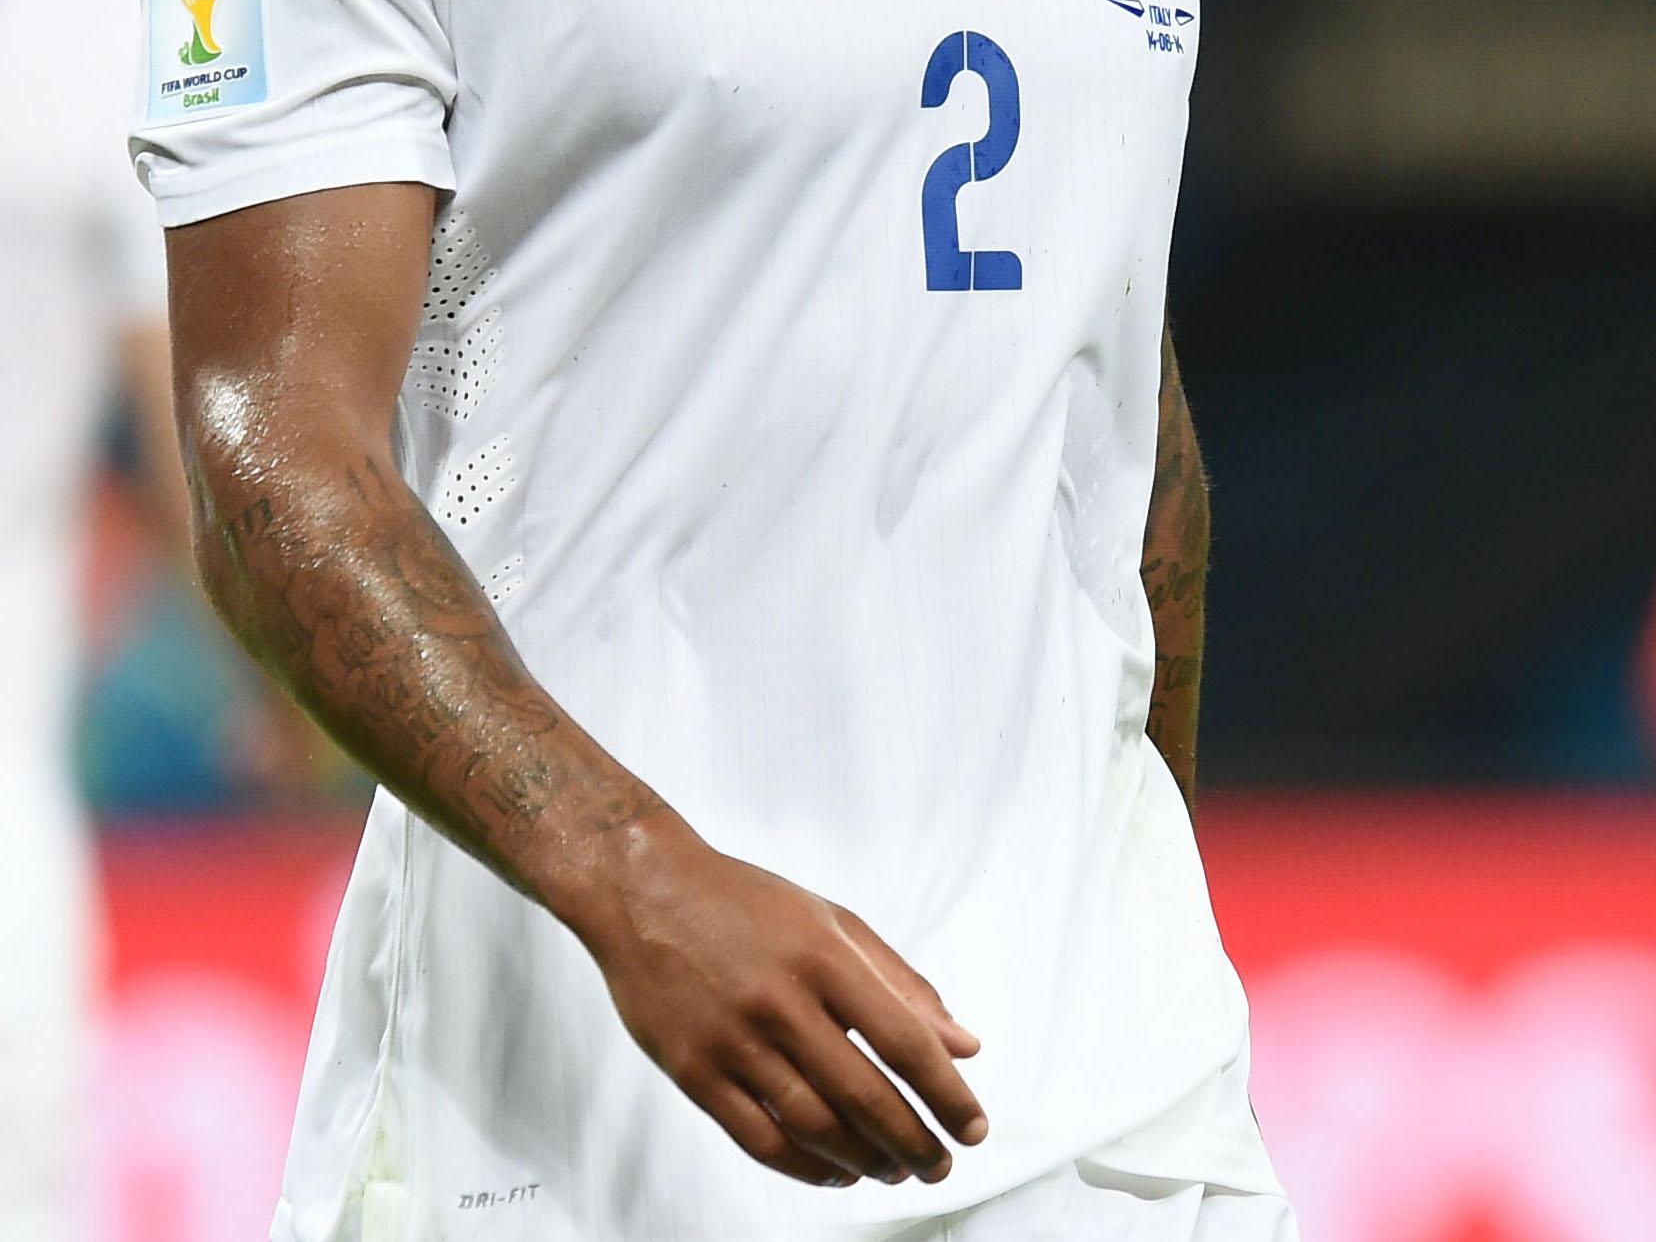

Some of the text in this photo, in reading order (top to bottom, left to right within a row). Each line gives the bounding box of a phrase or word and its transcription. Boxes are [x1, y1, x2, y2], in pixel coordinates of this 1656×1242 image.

[1148, 4, 1171, 27] ITALY
[161, 67, 248, 95] FIFA WORLD CUP
[920, 30, 1023, 291] 2
[458, 1183, 541, 1209] DRI-FIT
